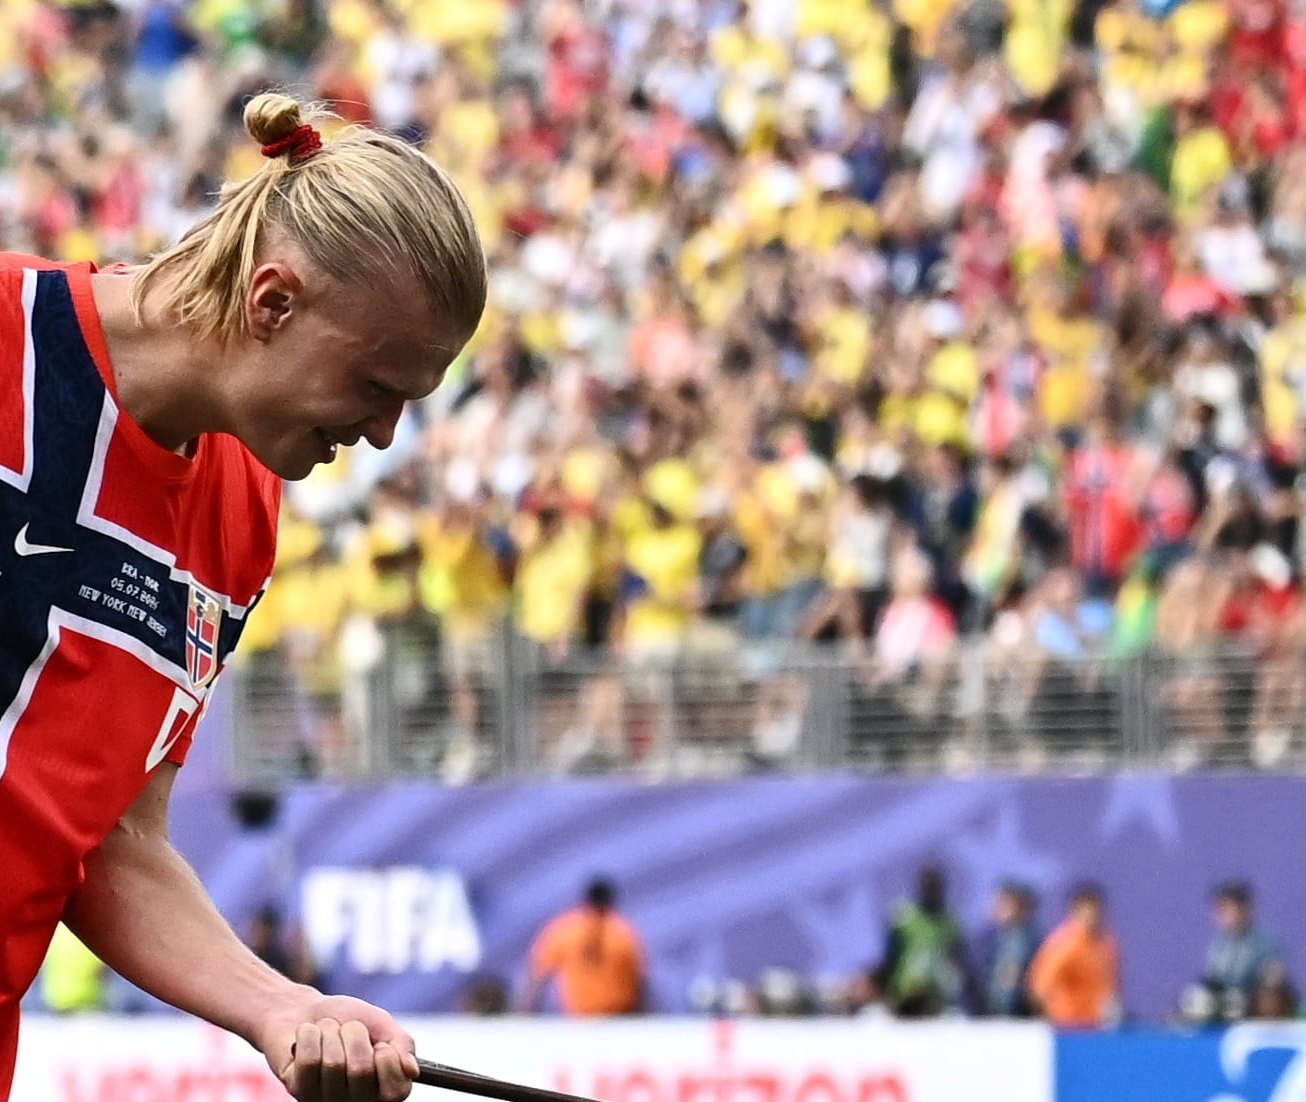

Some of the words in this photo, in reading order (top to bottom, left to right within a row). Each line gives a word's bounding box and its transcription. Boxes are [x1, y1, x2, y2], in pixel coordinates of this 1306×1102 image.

[110, 577, 160, 610] 05.07.2026
[121, 562, 138, 579] BRA
[144, 575, 160, 592] NOR
[78, 584, 102, 602] NEW
[101, 593, 128, 614] YORK
[126, 604, 148, 622] NEW
[302, 868, 483, 972] FIFA
